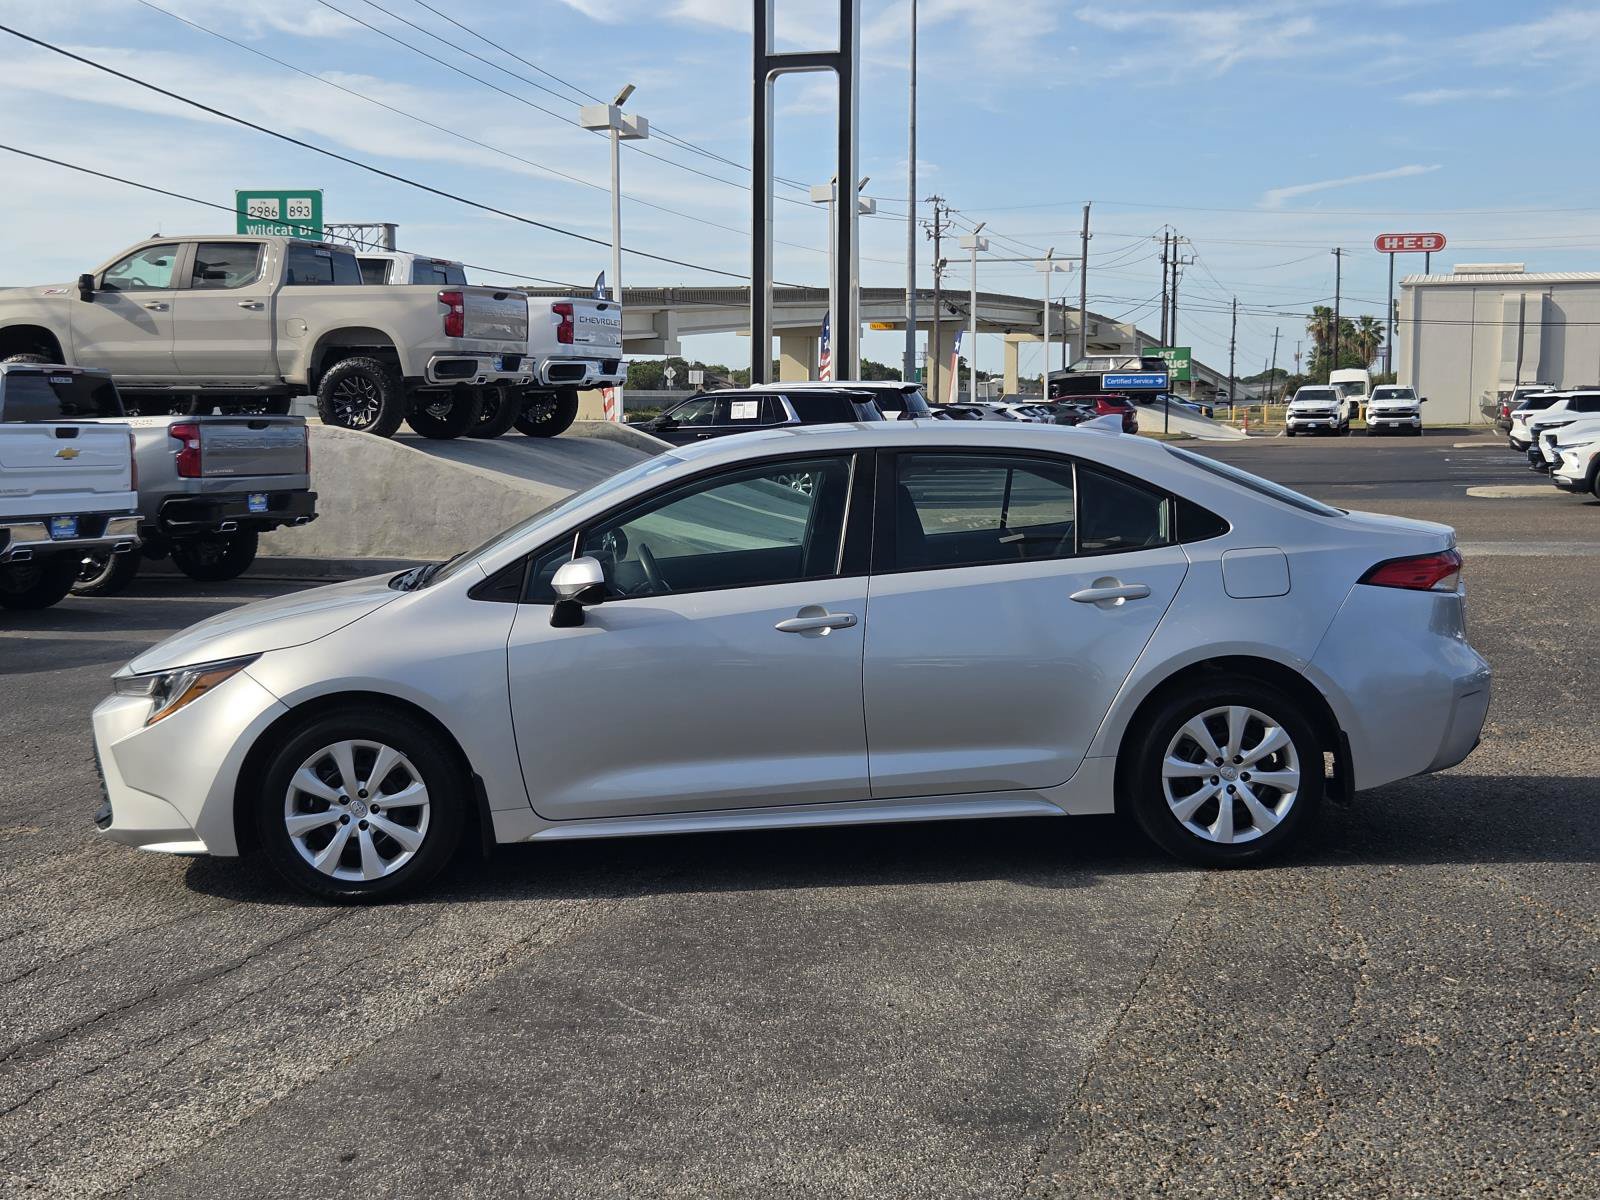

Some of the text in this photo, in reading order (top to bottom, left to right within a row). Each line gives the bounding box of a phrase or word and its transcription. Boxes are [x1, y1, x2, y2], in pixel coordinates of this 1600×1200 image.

[249, 206, 278, 217] 2986
[289, 206, 310, 217] 893
[246, 224, 313, 235] Wildcat Dr
